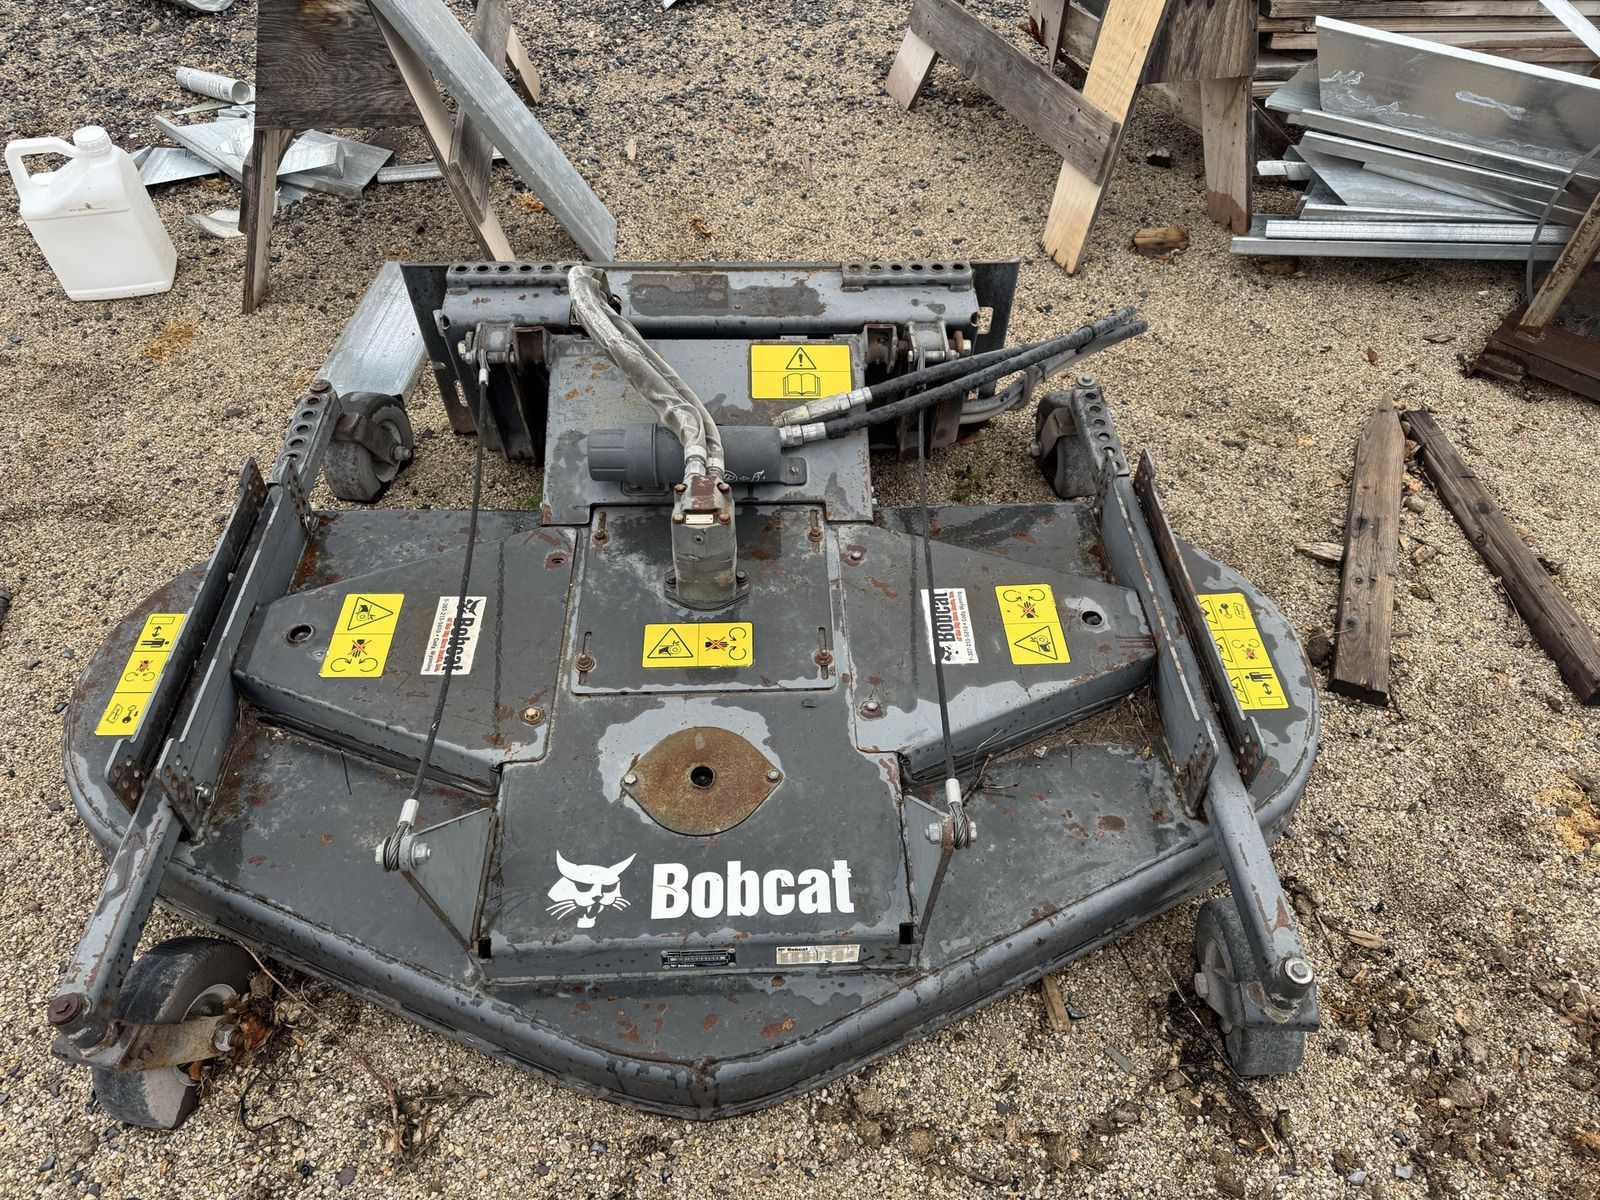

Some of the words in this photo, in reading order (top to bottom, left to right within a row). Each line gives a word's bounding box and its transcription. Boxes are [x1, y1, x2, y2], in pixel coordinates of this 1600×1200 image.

[441, 617, 475, 672] Bobcat
[932, 592, 956, 642] Bobcat
[651, 860, 855, 919] Bobcat
